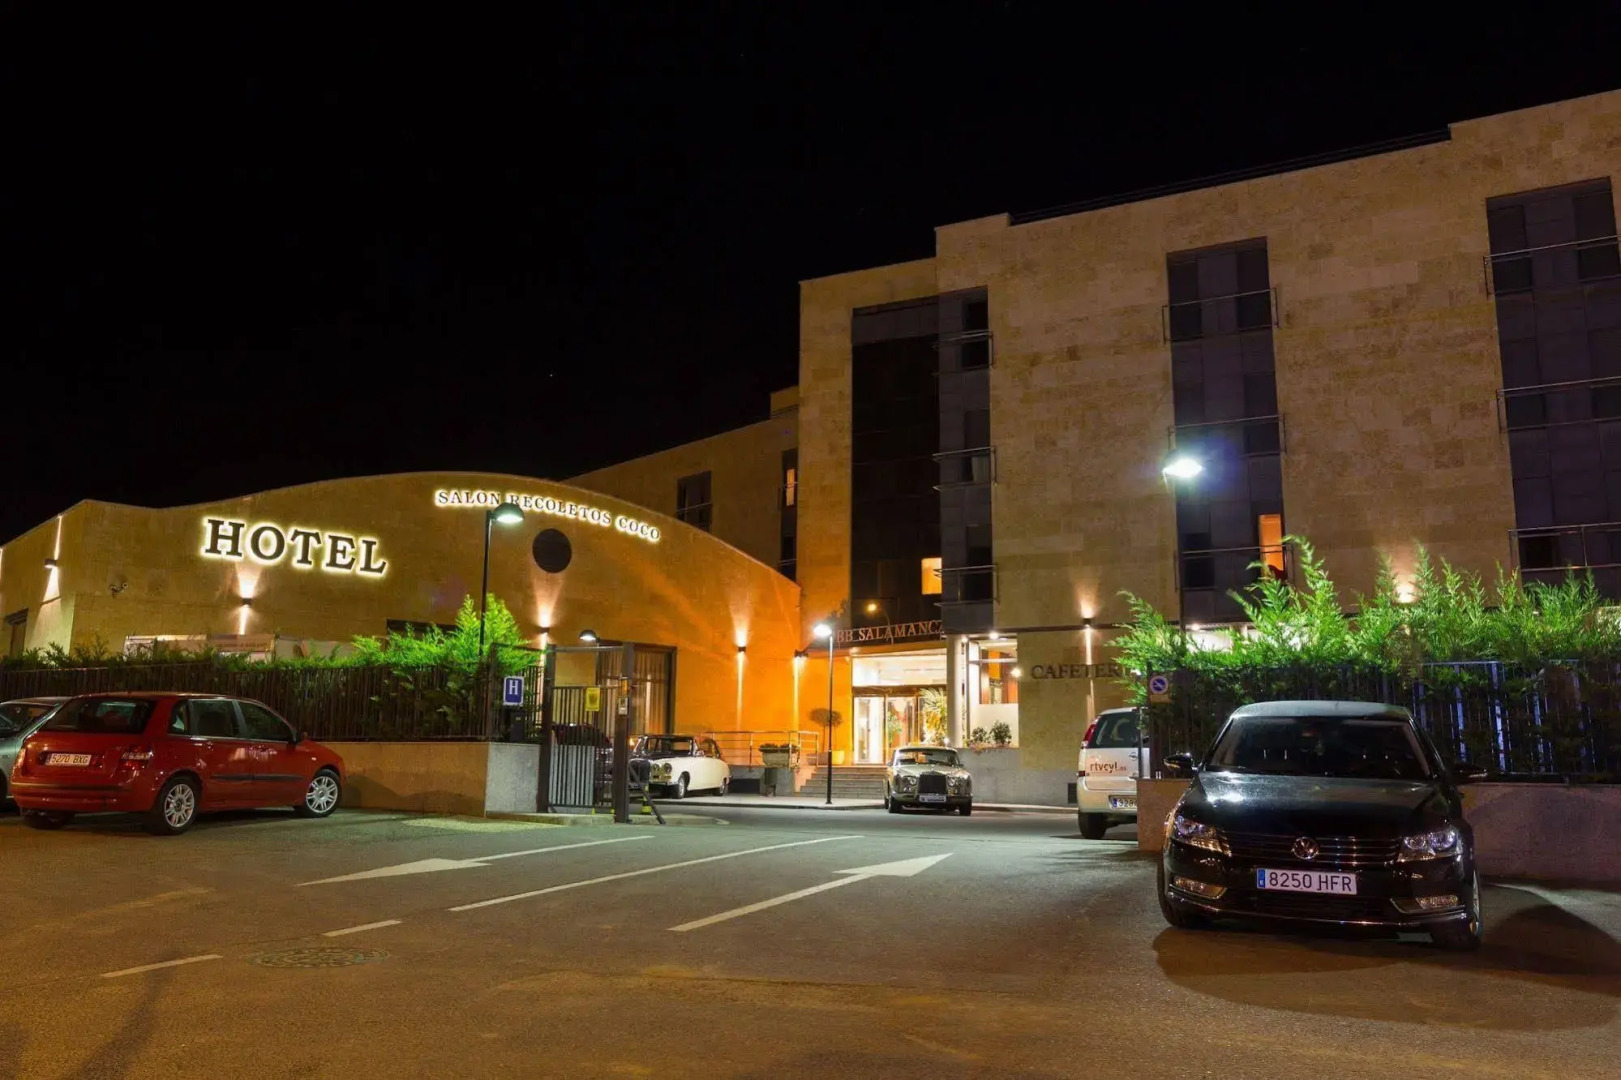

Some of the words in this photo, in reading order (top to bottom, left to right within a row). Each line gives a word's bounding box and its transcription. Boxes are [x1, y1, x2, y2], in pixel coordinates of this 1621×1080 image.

[509, 494, 612, 525] RECOLETOS
[618, 514, 660, 541] COCO
[205, 518, 387, 574] HOTEL
[1031, 663, 1126, 680] CAFETER
[509, 679, 520, 695] H
[1269, 871, 1312, 889] 8250
[1318, 874, 1352, 892] HFR
